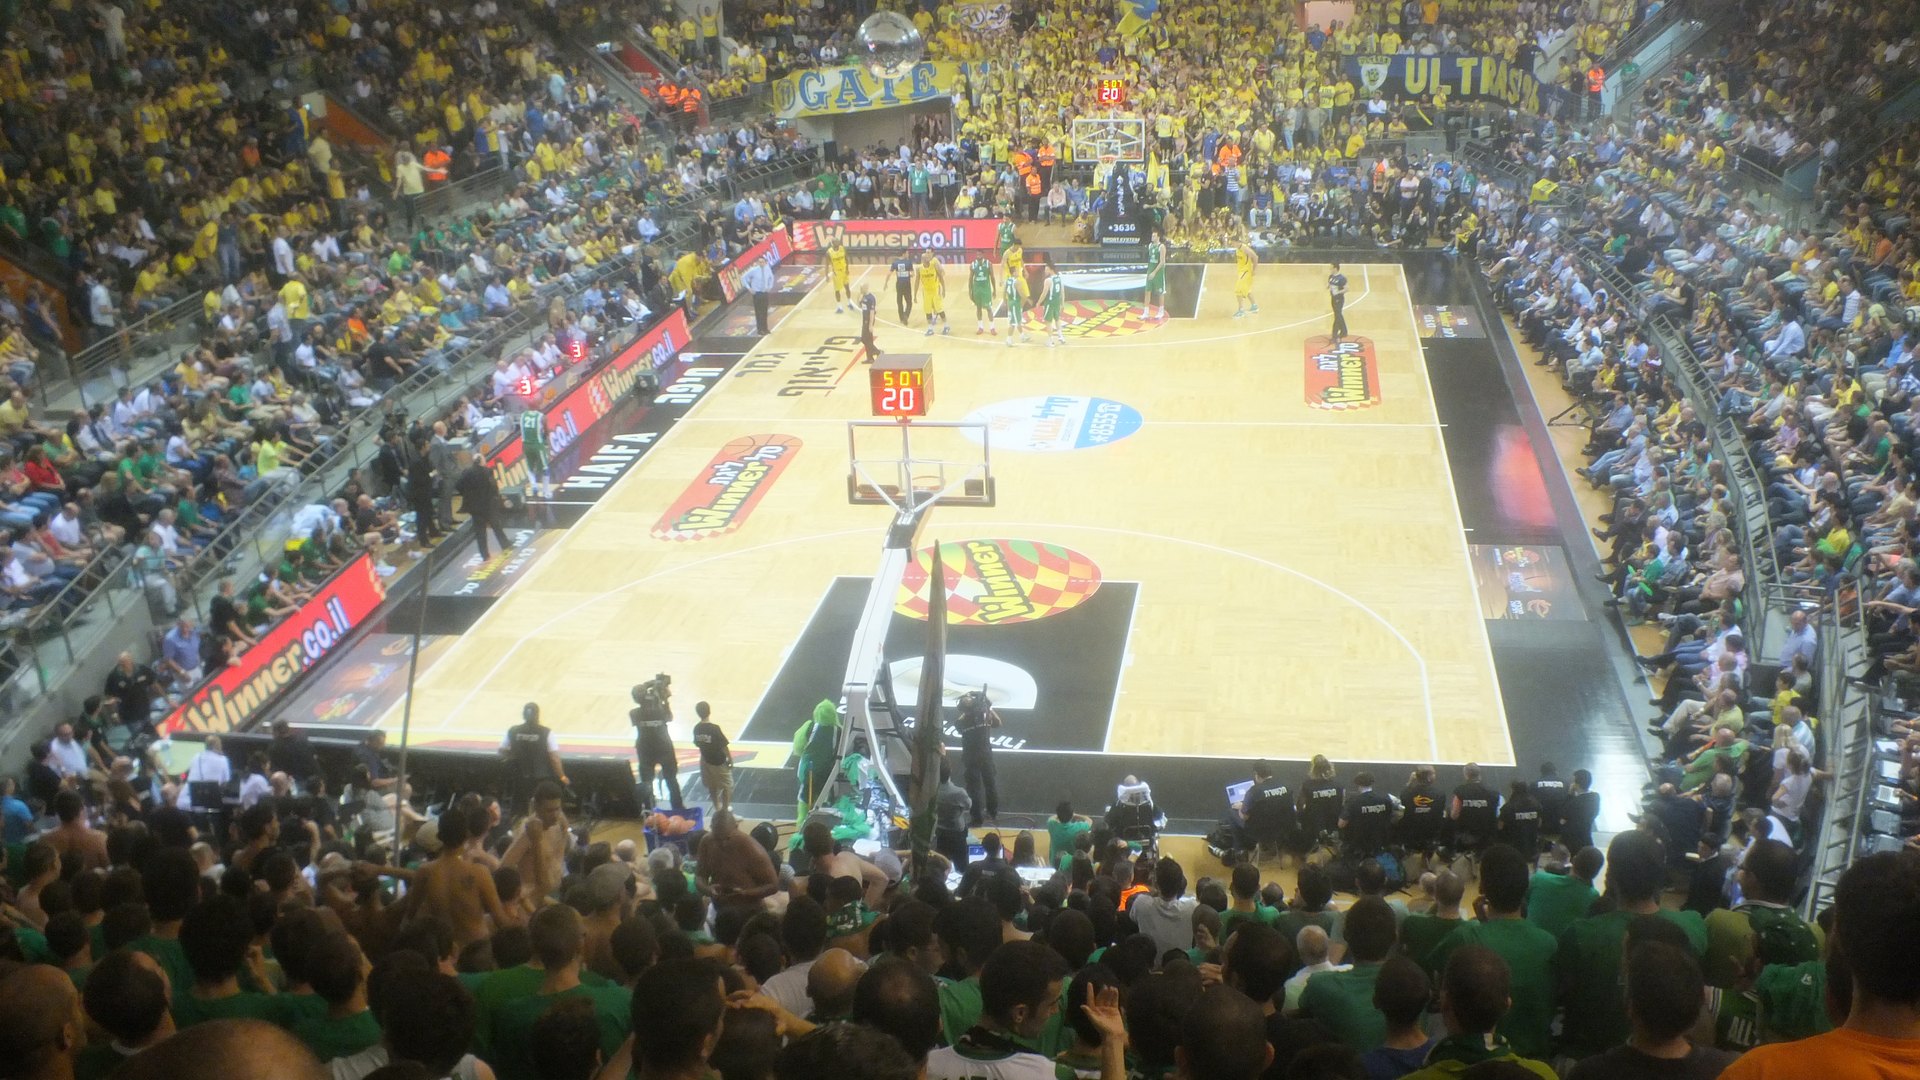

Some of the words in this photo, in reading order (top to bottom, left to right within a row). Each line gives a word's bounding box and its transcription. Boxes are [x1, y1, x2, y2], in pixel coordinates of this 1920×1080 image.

[799, 62, 938, 111] GATE
[1102, 88, 1119, 100] 20
[815, 223, 965, 249] Winner.co.il
[572, 344, 582, 358] 3
[735, 351, 790, 378] גמר
[520, 379, 532, 395] 3
[1326, 353, 1365, 403] Winner
[882, 388, 914, 410] 20
[524, 416, 536, 429] 21
[562, 432, 658, 488] HAIFA
[677, 461, 769, 530] Winner
[967, 541, 1031, 622] Winner
[187, 596, 352, 734] Winner.co.il
